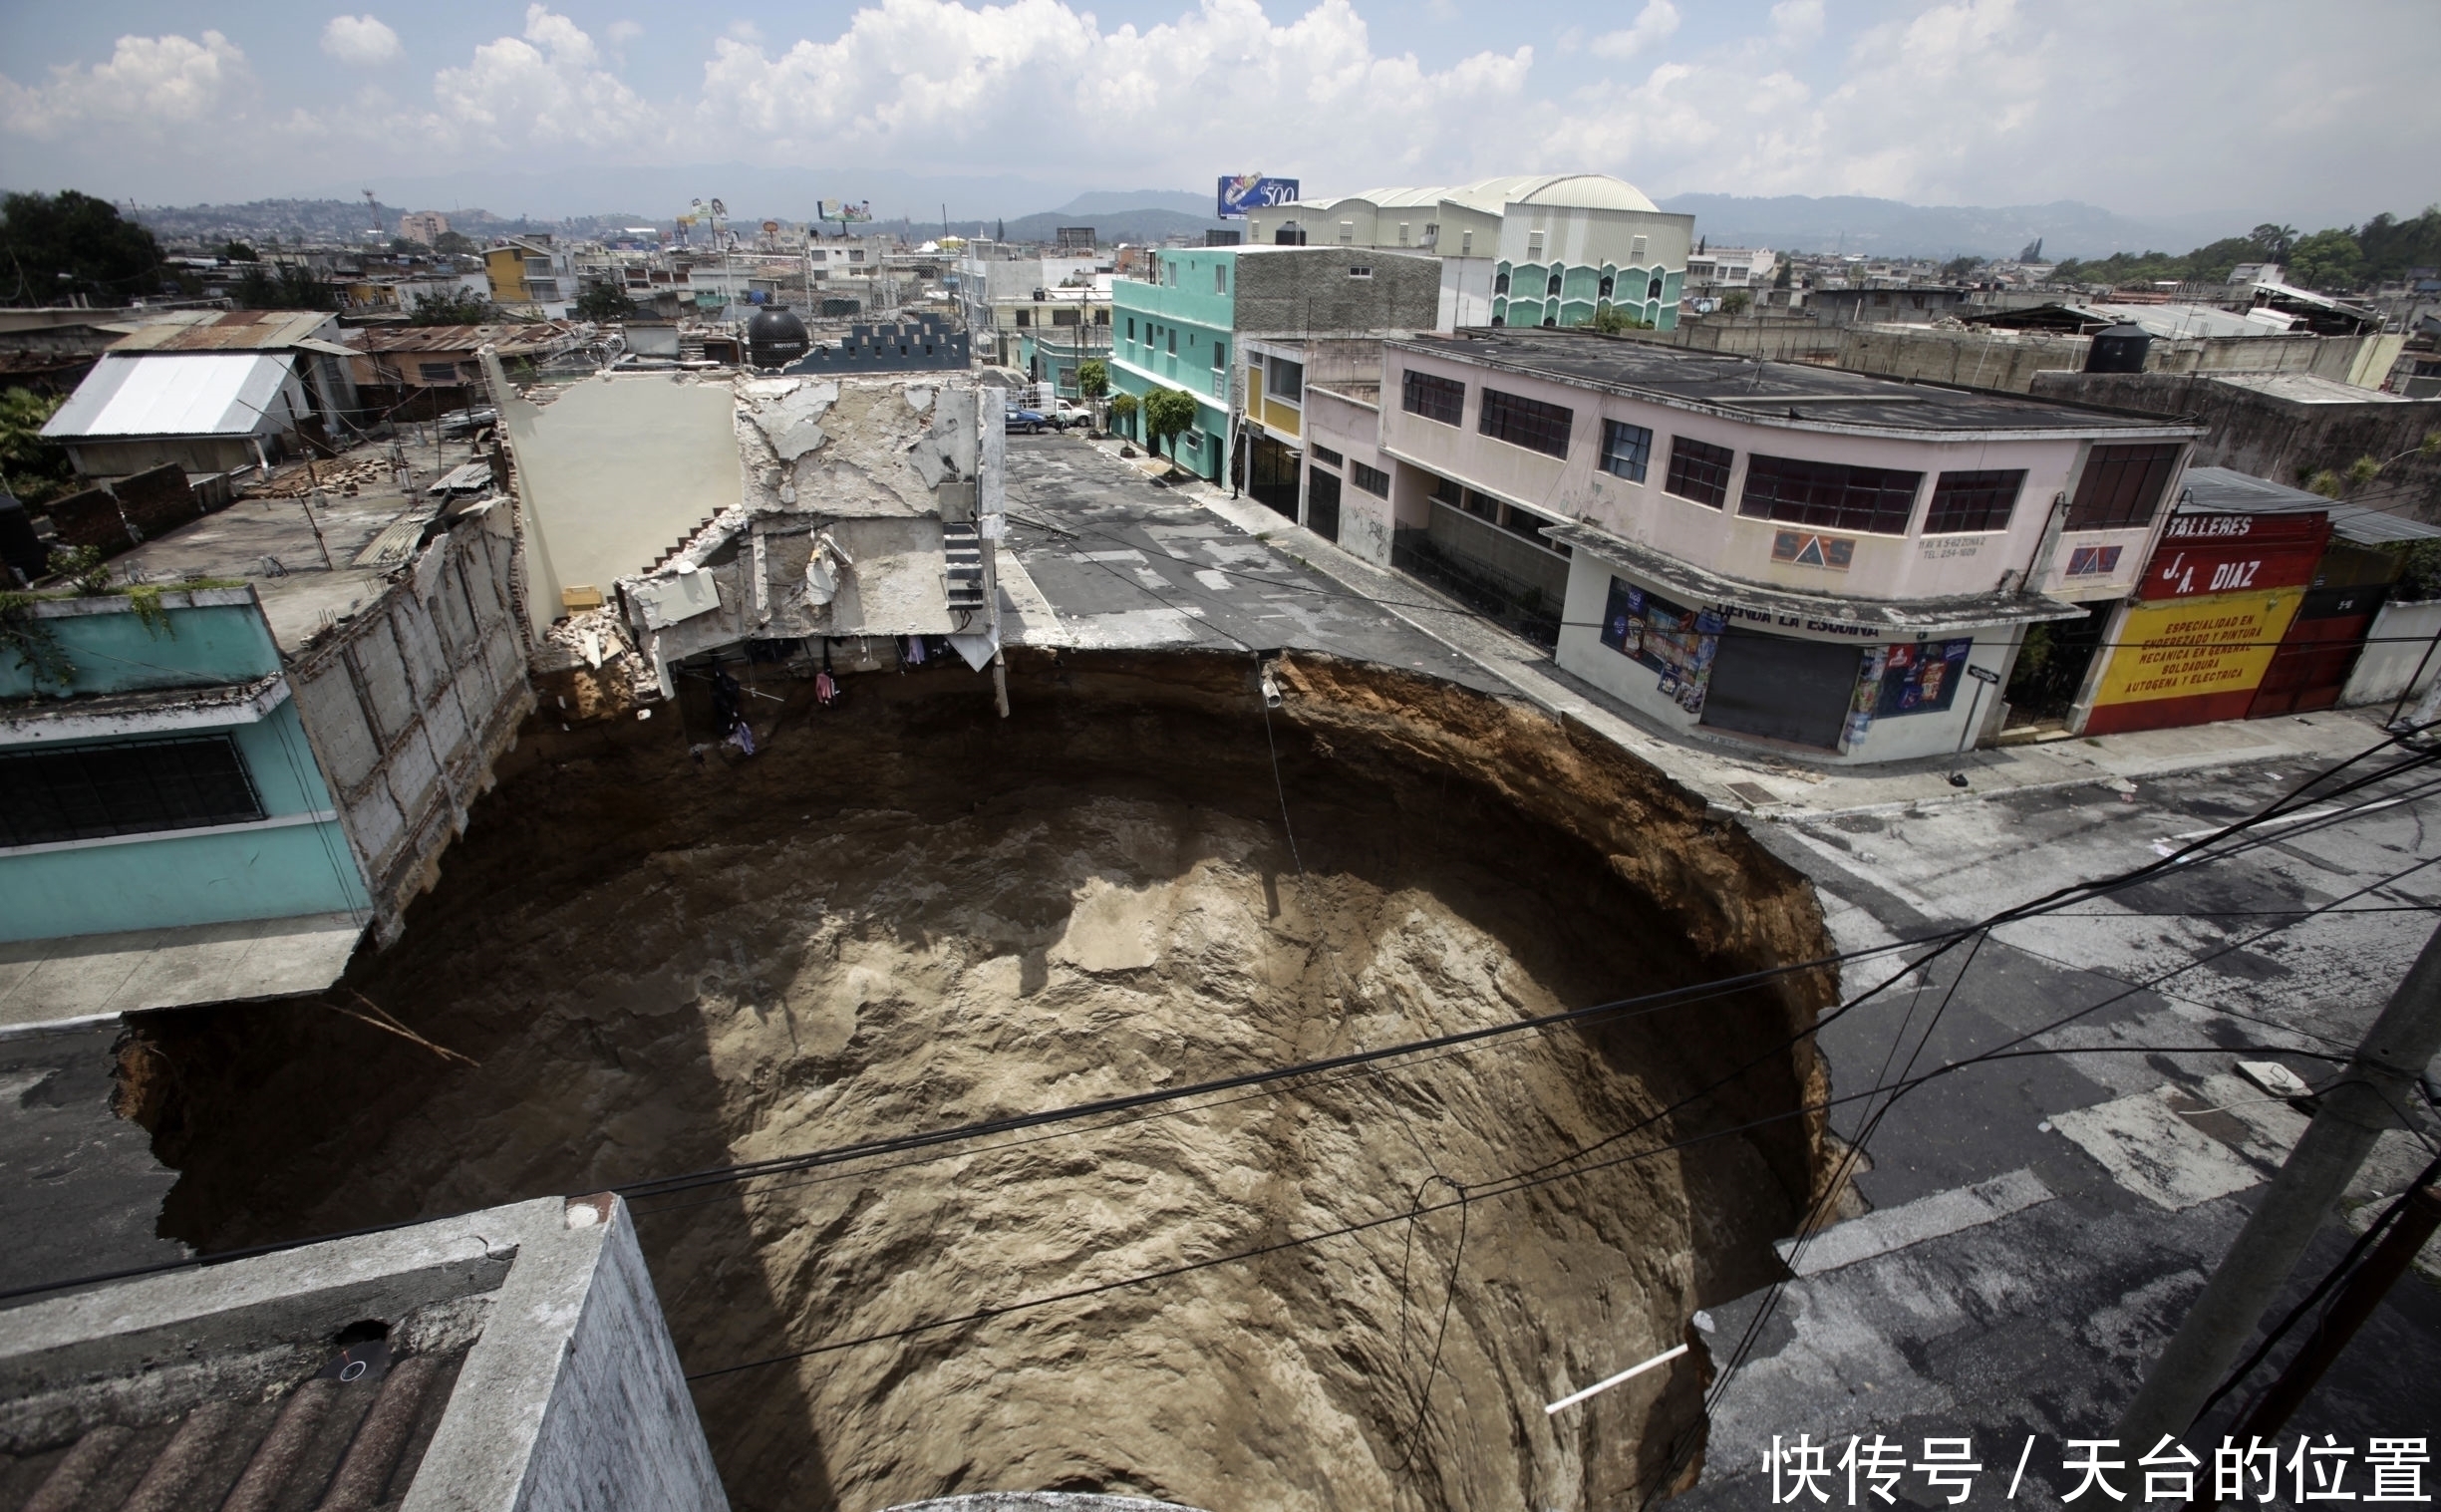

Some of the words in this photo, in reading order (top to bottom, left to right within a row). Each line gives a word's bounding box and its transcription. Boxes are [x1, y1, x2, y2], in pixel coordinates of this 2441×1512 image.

[2166, 516, 2253, 538] TALLERES
[2163, 552, 2185, 580] J.
[2176, 566, 2194, 593] A.
[2209, 561, 2262, 590] DIAZ
[1778, 616, 1799, 628] LA
[2165, 617, 2238, 635] ESPECIALIDAD
[2240, 614, 2256, 626] EN
[2212, 631, 2220, 642] Y
[2220, 627, 2263, 642] PINTURA
[2139, 649, 2189, 665] MECANICA
[2192, 646, 2205, 658] EN
[2208, 642, 2252, 657] GENERAL
[2161, 659, 2221, 675] SOLDADURA
[2125, 678, 2178, 694] AUTOGENA
[2190, 668, 2244, 685] ELECTRICA
